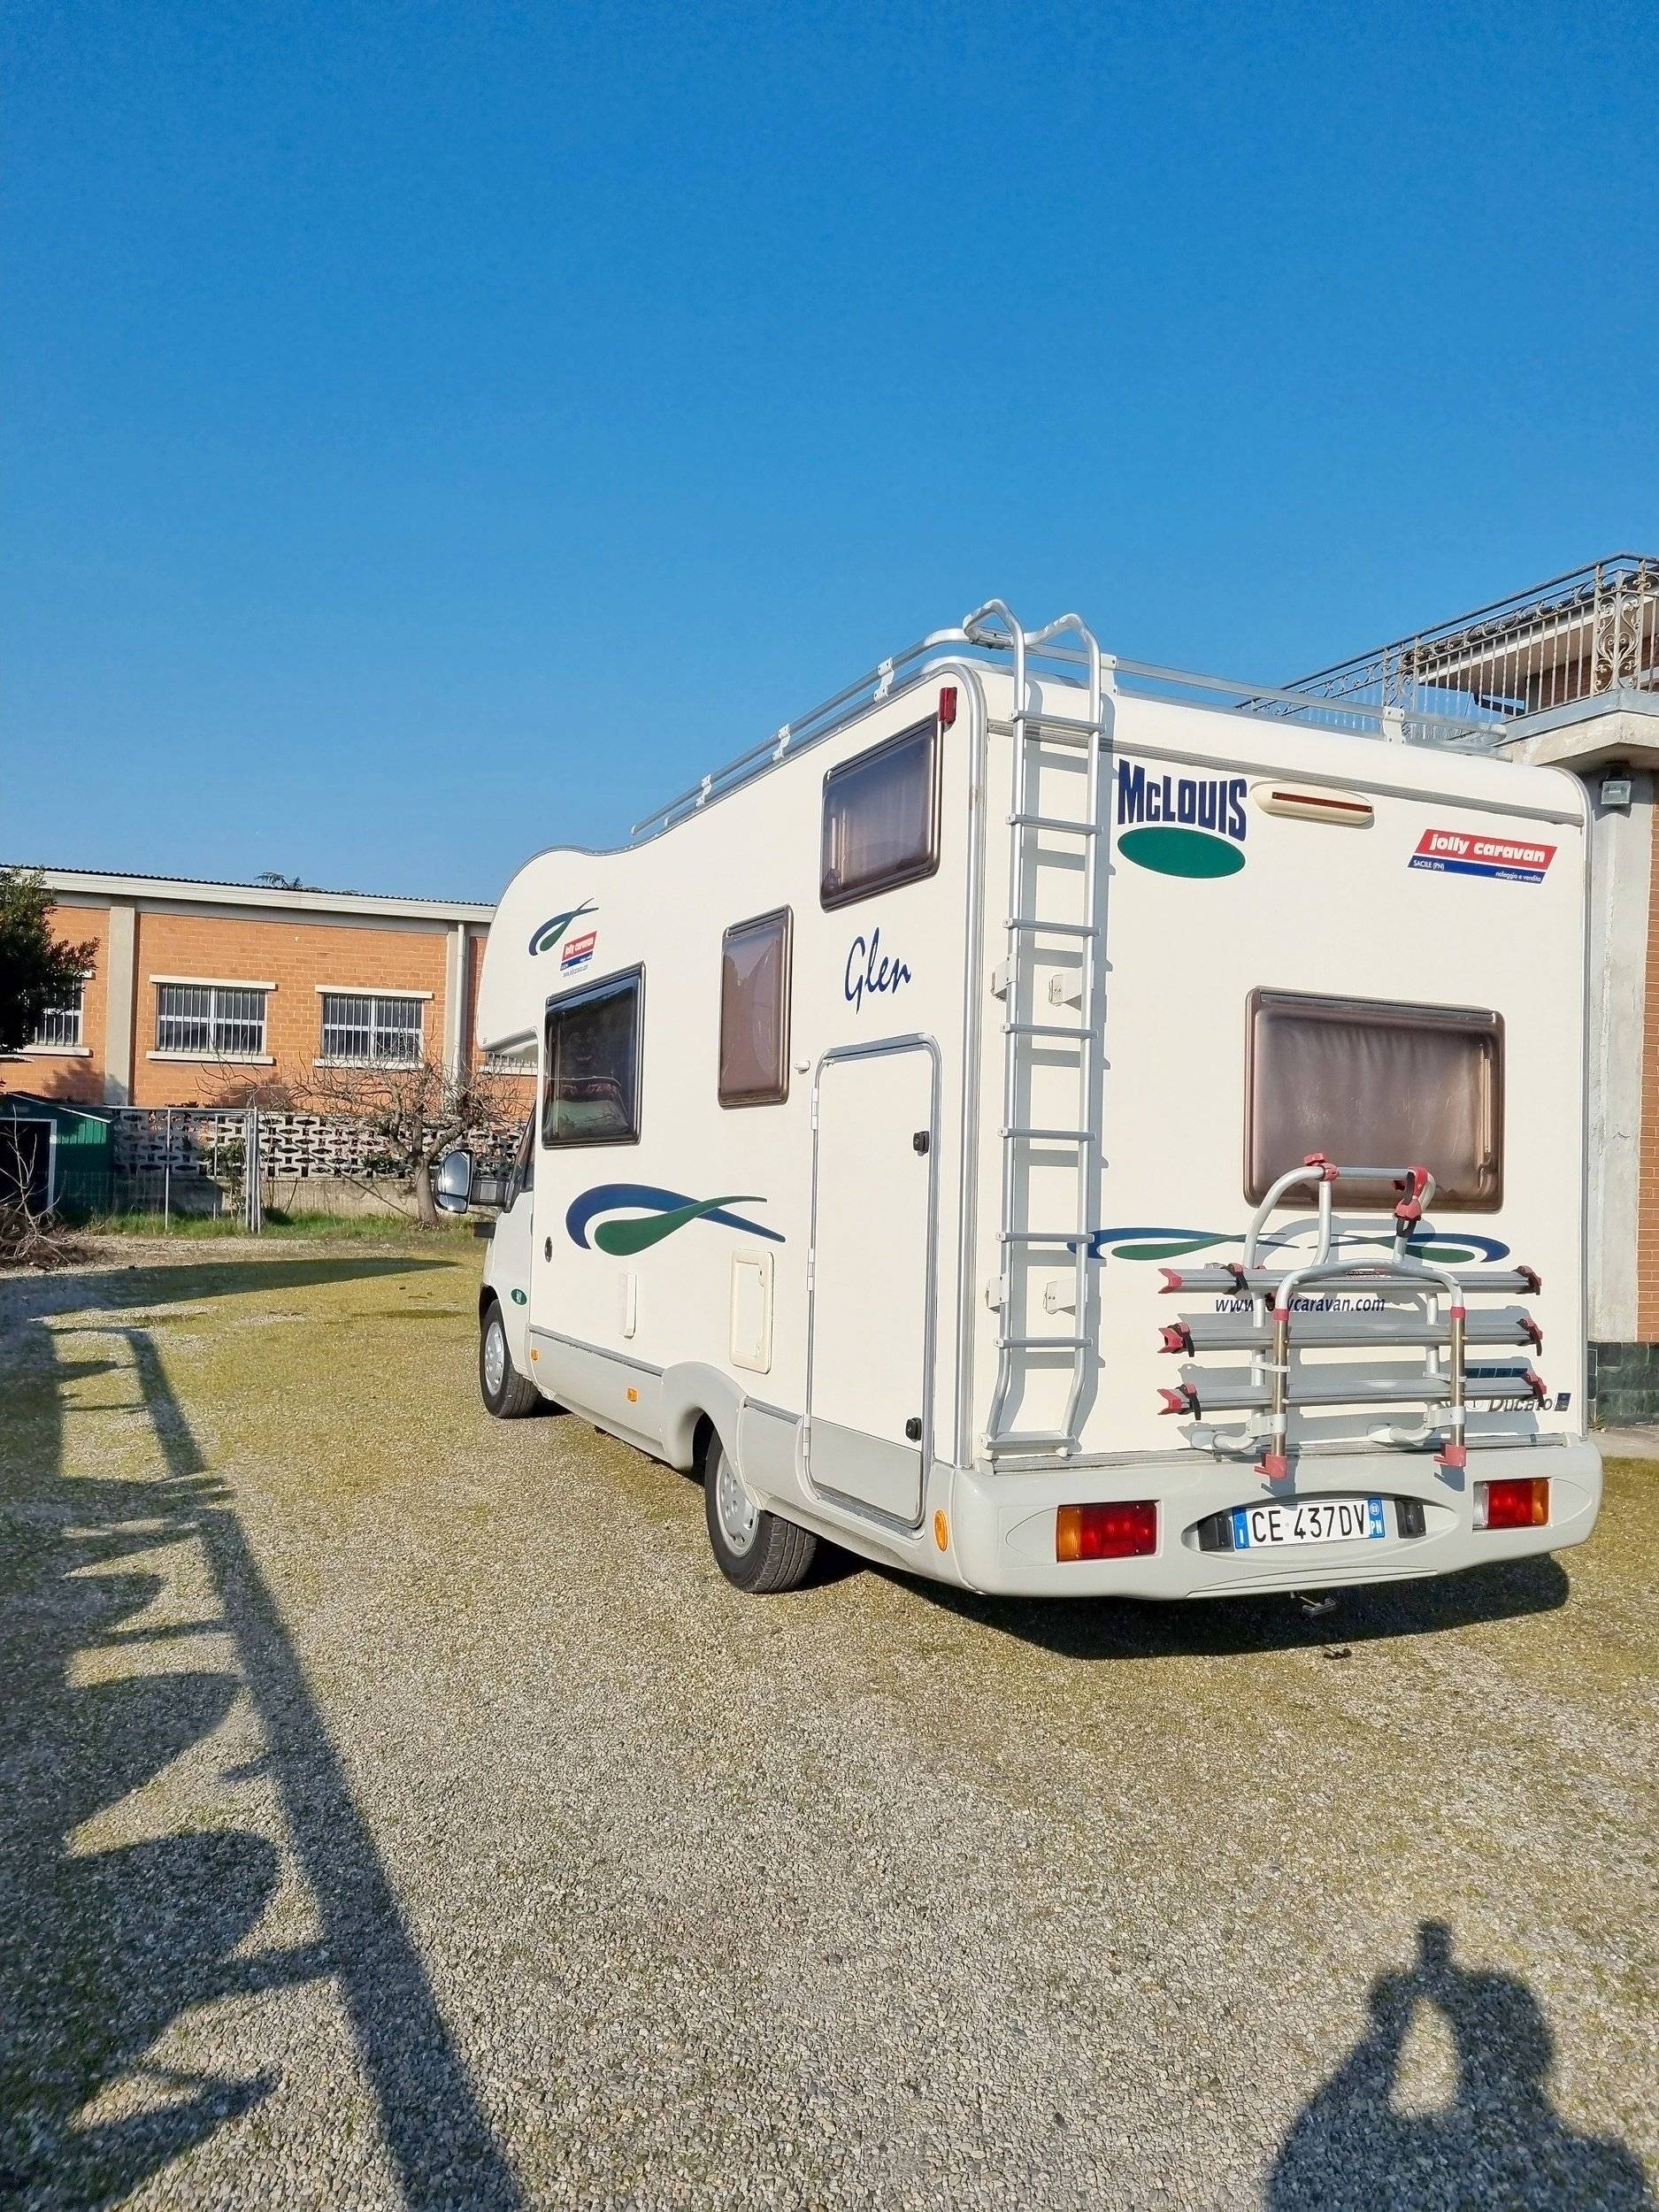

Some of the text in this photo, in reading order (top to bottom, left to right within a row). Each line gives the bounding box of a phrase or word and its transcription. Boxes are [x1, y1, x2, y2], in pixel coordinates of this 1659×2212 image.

[1430, 834, 1546, 863] jolly caravan
[1413, 860, 1432, 869] SACILE
[844, 926, 912, 1015] Glen
[1251, 1509, 1284, 1543] CE
[1294, 1503, 1365, 1540] 437DV
[1371, 1519, 1382, 1535] PN
